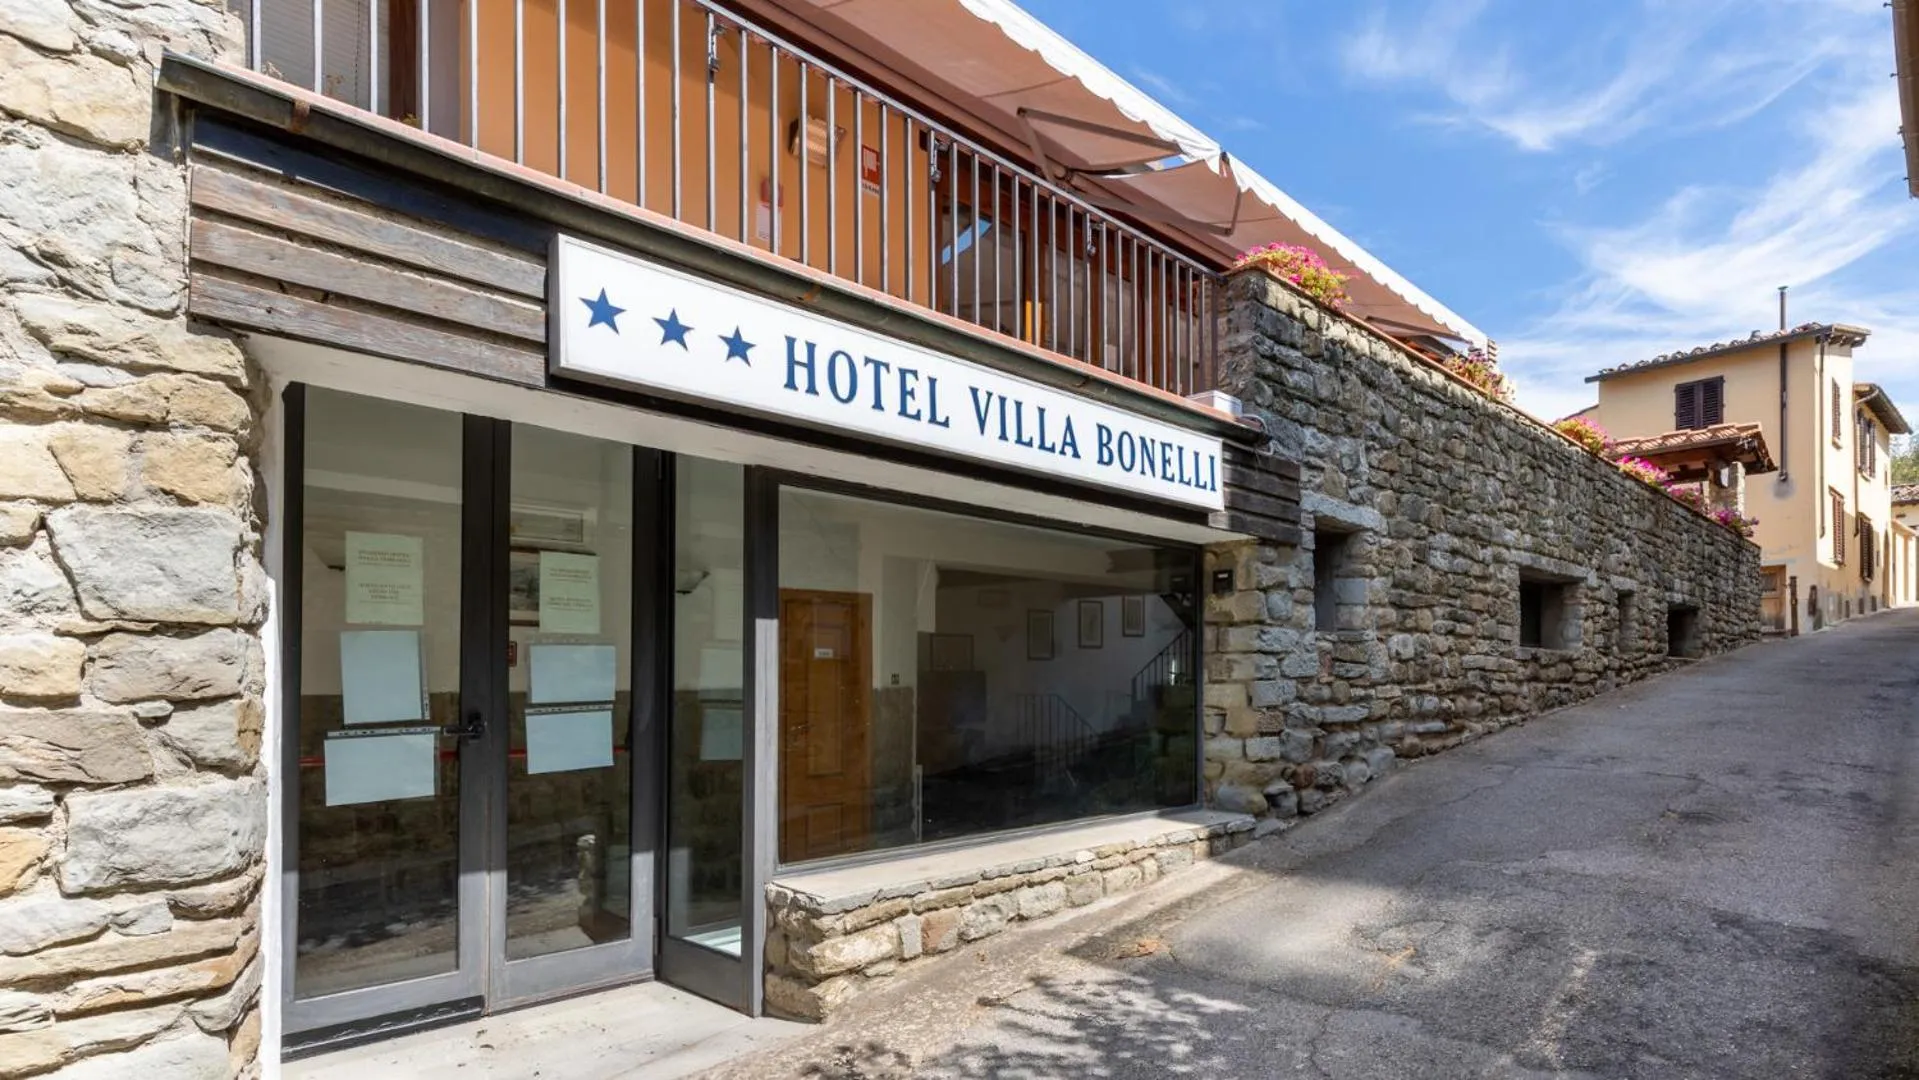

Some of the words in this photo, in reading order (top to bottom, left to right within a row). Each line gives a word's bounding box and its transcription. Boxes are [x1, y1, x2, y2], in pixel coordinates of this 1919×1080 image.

[783, 335, 950, 429] HOTEL
[968, 386, 1081, 460] VILLA
[1096, 423, 1217, 493] BONELLI
